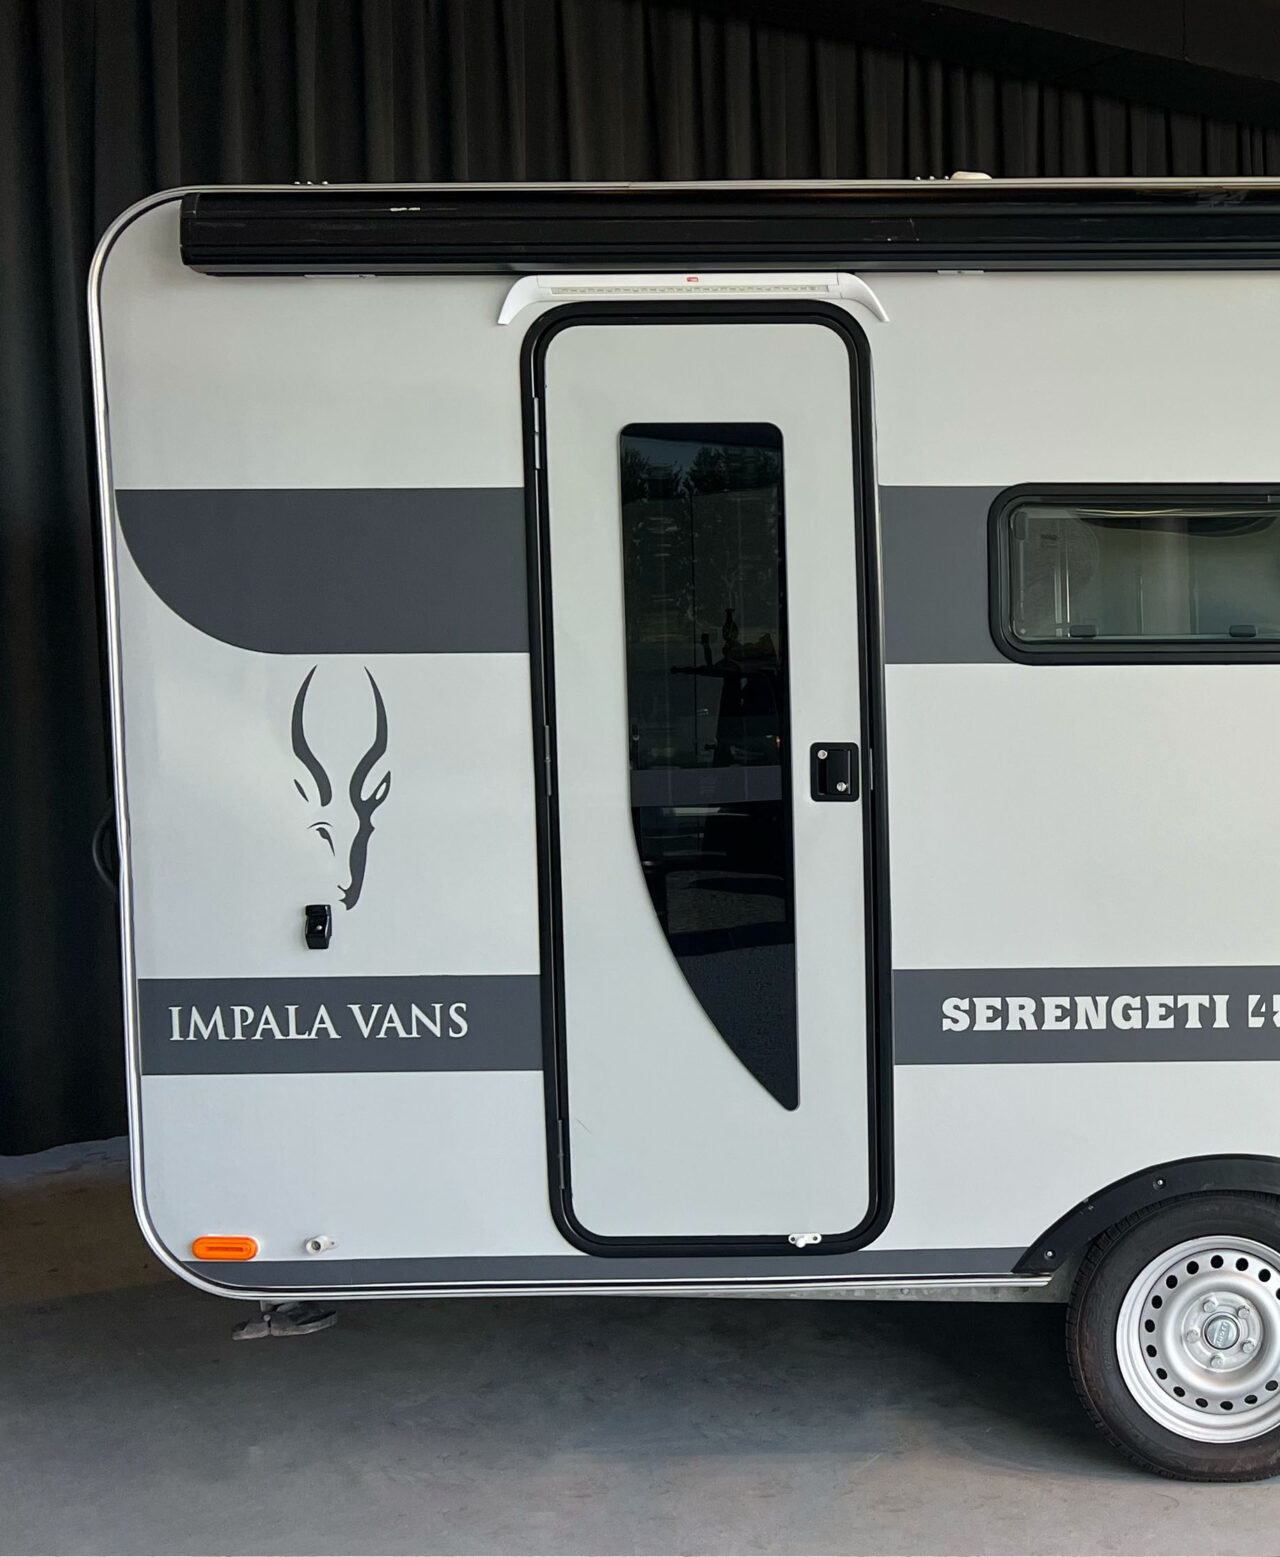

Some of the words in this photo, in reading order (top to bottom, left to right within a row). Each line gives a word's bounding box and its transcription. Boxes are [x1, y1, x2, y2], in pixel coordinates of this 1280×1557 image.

[168, 1004, 342, 1041] IMPALA
[346, 1002, 468, 1039] VANS
[941, 994, 1231, 1032] SERENGETI
